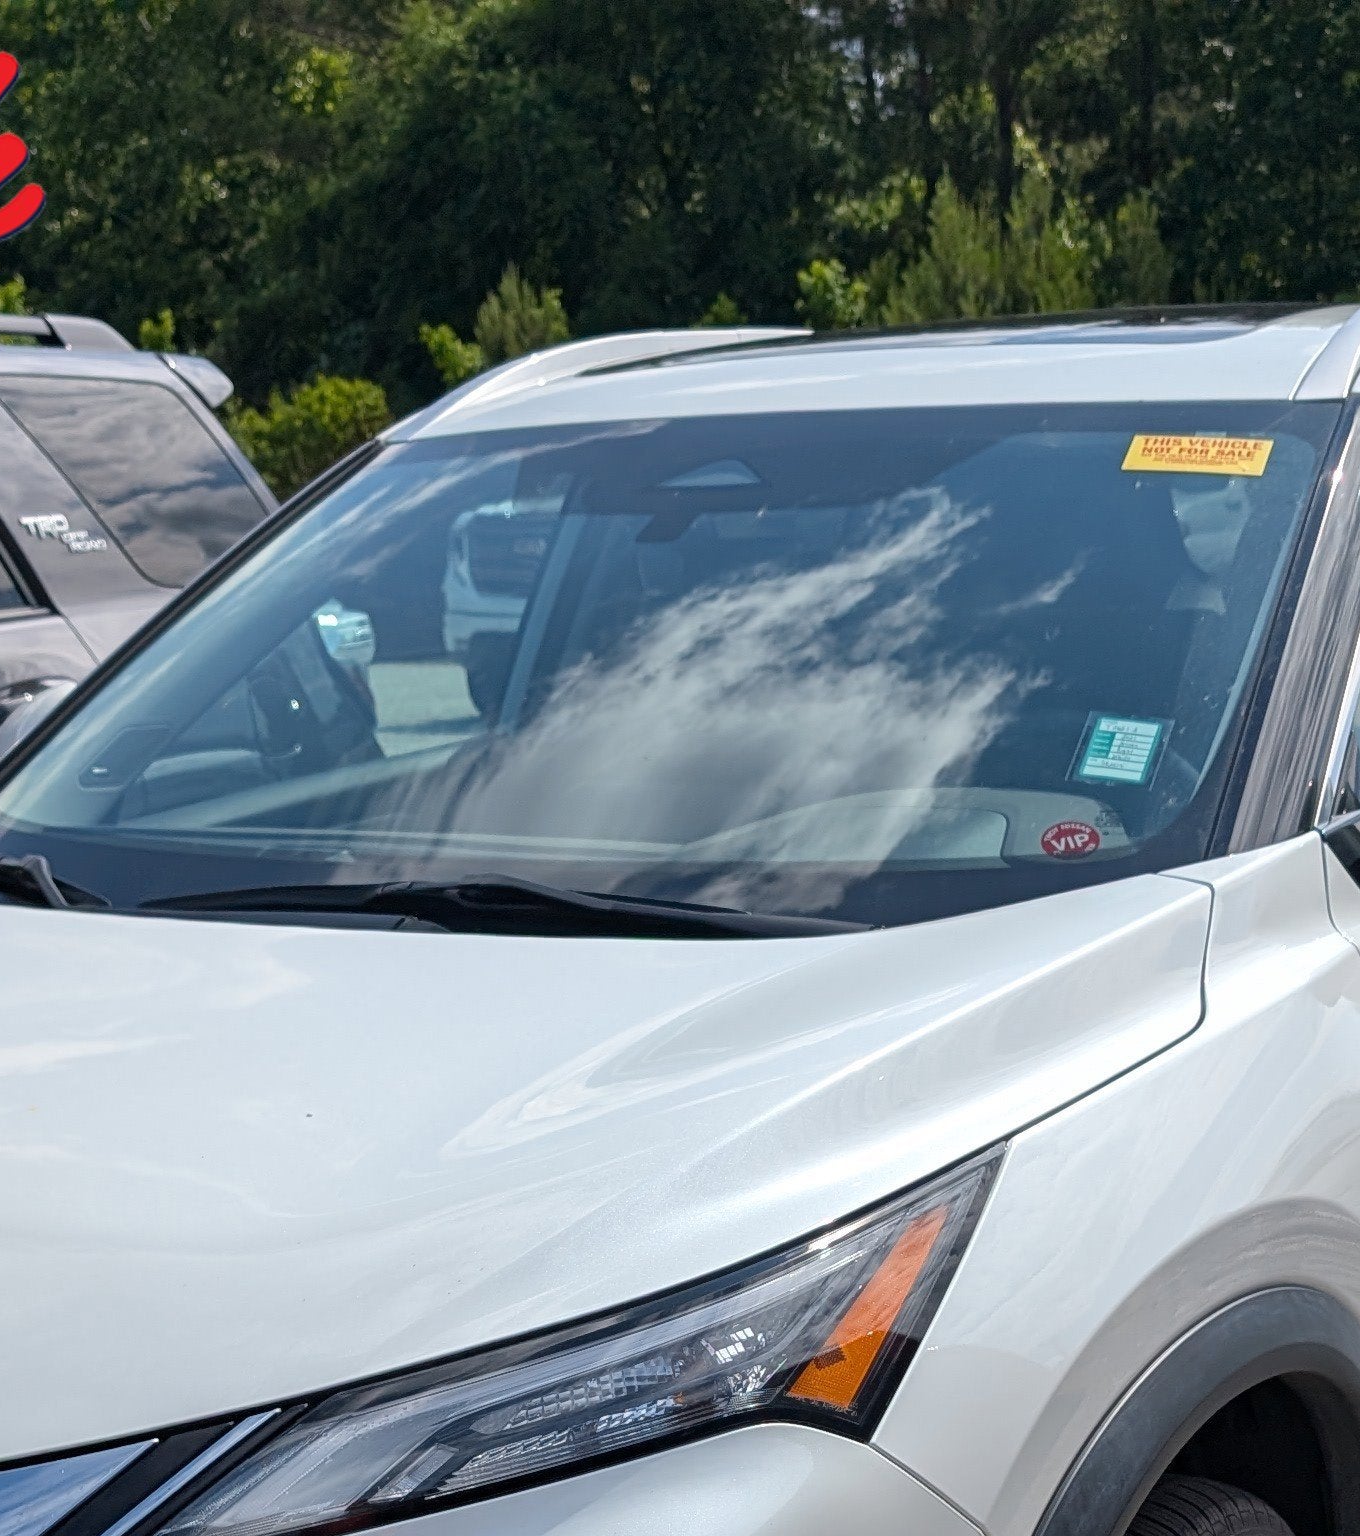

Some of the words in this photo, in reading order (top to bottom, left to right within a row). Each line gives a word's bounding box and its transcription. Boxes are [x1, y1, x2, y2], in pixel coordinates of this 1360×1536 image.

[1141, 446, 1172, 455] NOT
[1178, 447, 1210, 456] FOR
[1215, 449, 1258, 458] SALE
[1144, 438, 1182, 447] THIS
[1189, 439, 1264, 451] VEHICLE
[19, 513, 70, 540] TRD
[1050, 833, 1090, 851] VIP
